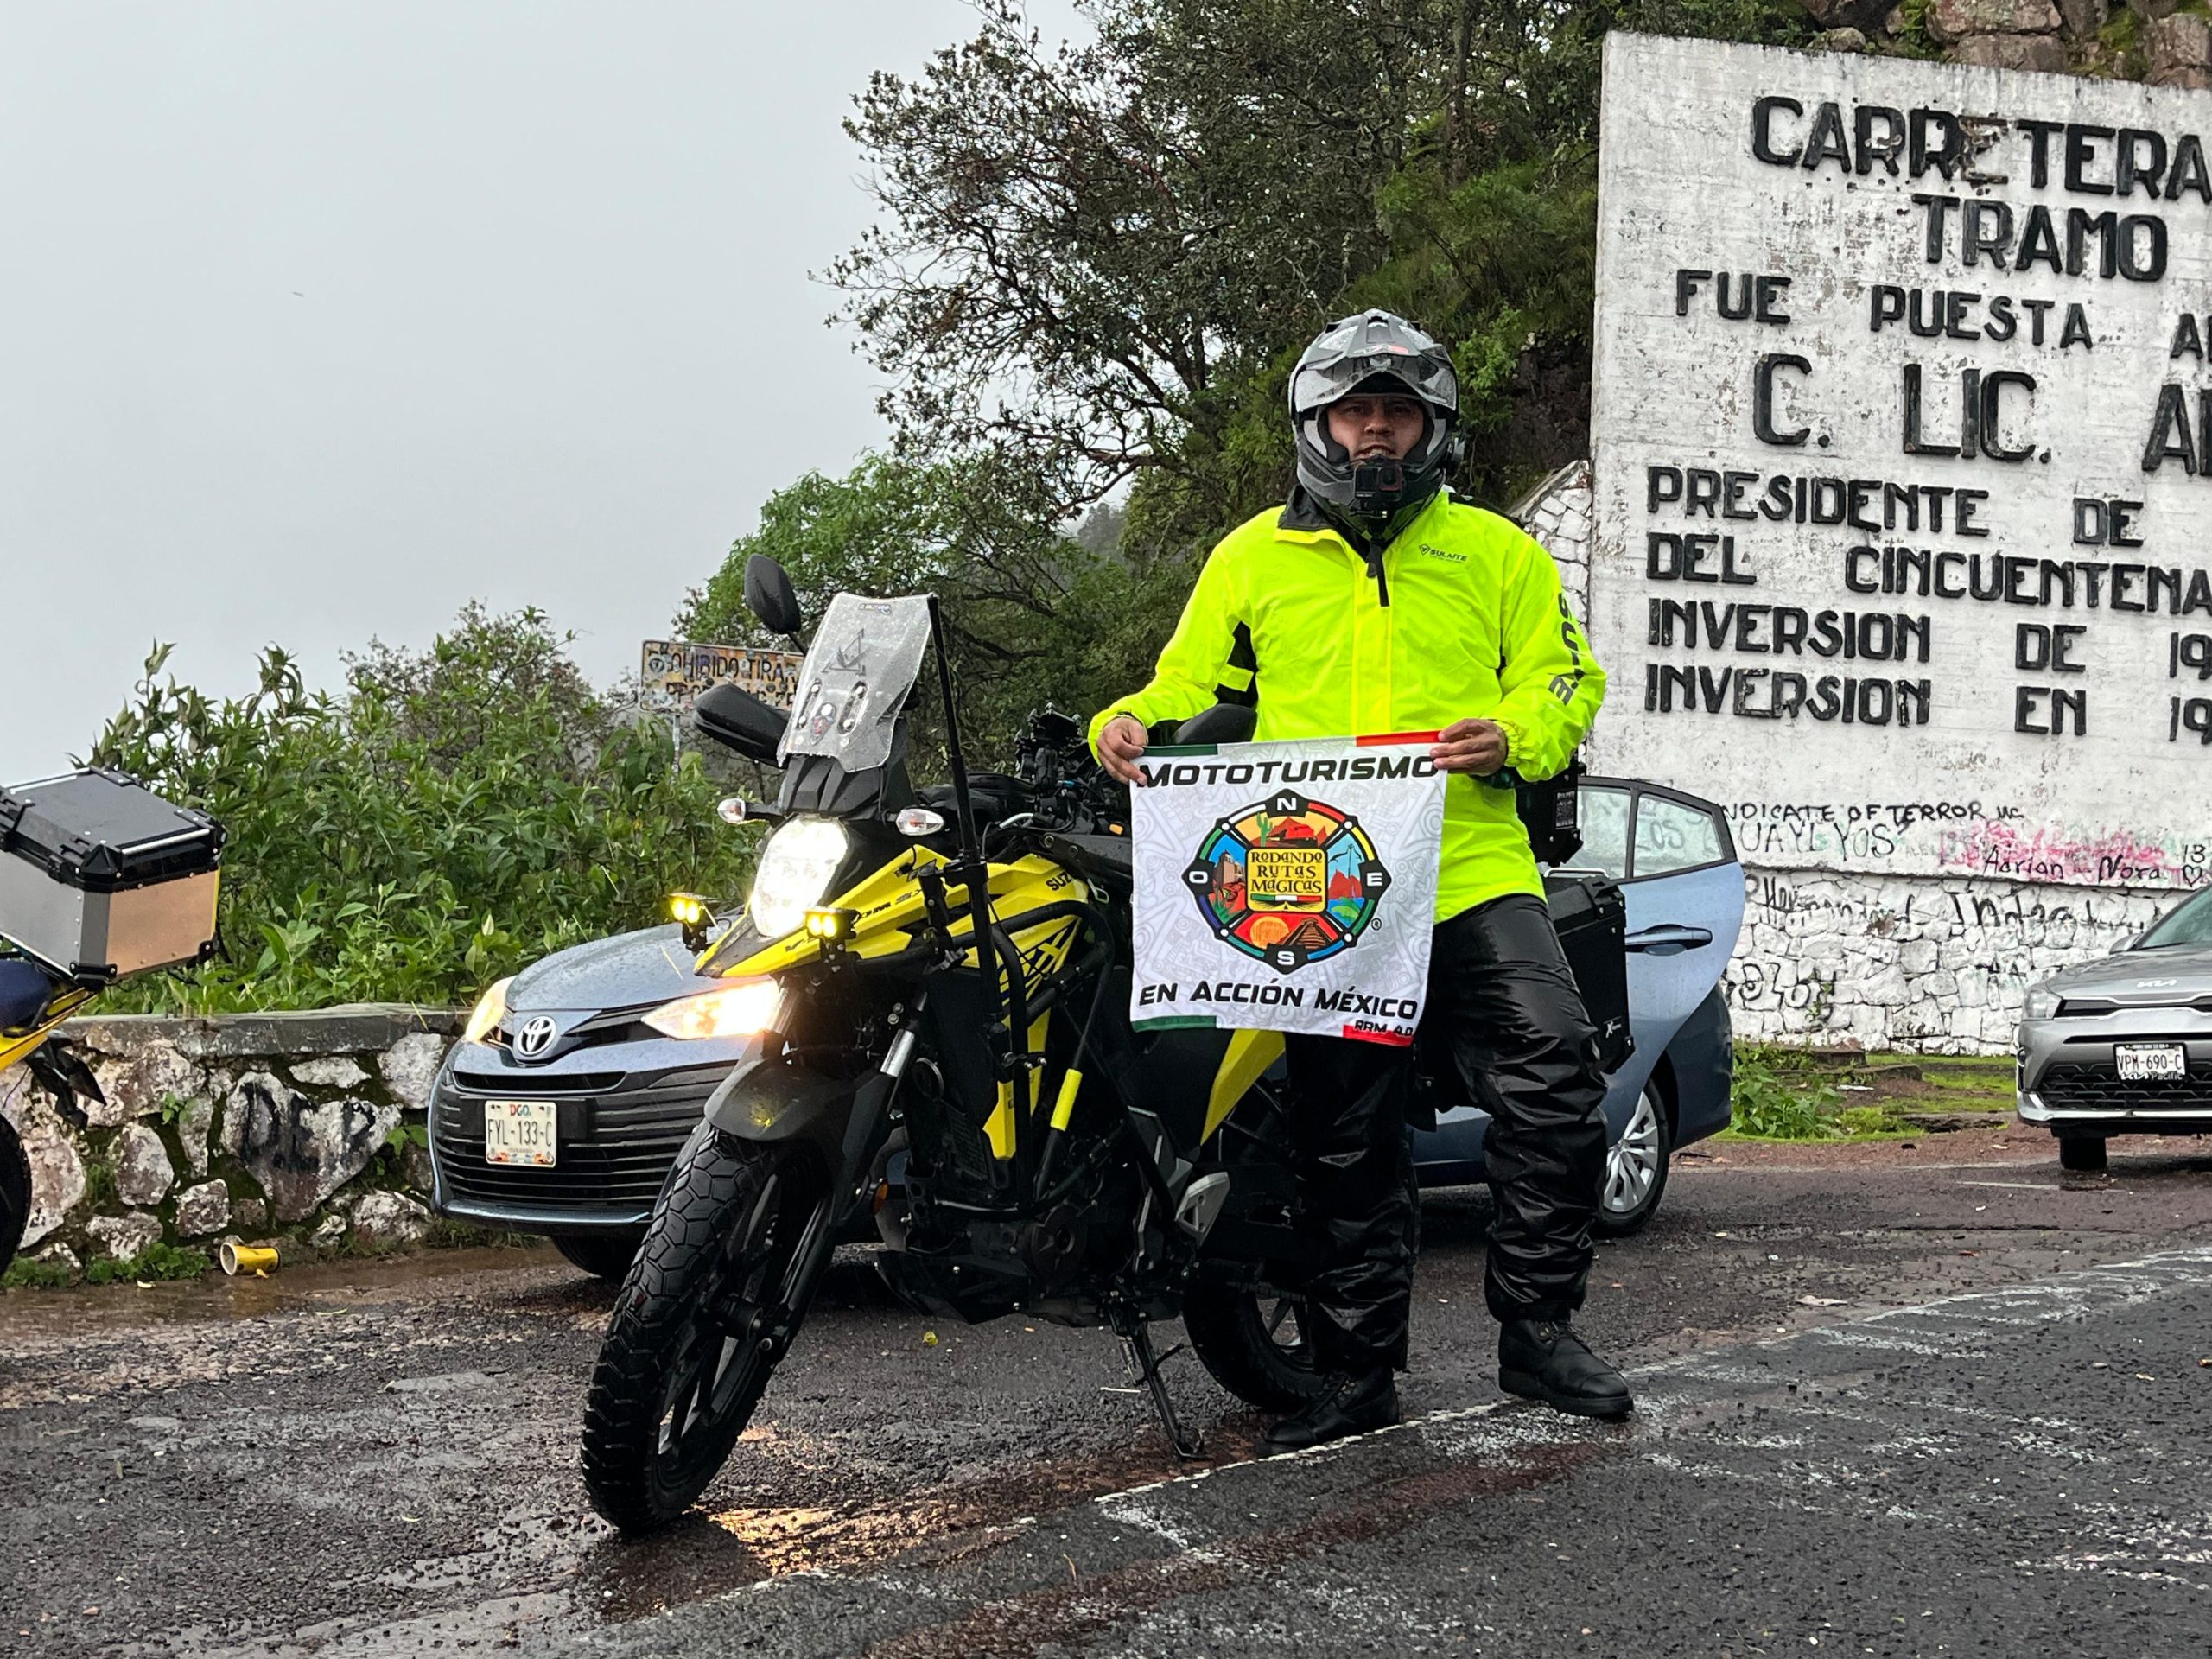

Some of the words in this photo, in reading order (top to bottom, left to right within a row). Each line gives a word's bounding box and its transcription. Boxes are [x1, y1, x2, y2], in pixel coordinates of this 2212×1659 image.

[1912, 194, 2168, 281] TRAMO
[1676, 269, 1791, 324] FUE
[1871, 285, 2092, 349] PUESTA
[1753, 353, 1830, 448] C.
[1904, 364, 2051, 464] LIC.
[1646, 466, 1989, 537] PRESIDENTE
[2074, 497, 2144, 547] DE
[1430, 549, 1468, 562] SULAITE
[1646, 531, 1758, 585] DEL
[1647, 597, 1931, 663] INVERSION
[2016, 622, 2087, 672] DE
[1644, 663, 1931, 727] INVERSION
[2015, 685, 2087, 736] EN
[1136, 755, 1440, 788] MOTOTURISMO
[1276, 798, 1296, 810] N
[1848, 804, 1881, 822] OF
[1886, 800, 1986, 828] TERROR
[1189, 871, 1208, 884] O
[1366, 872, 1383, 886] E
[2099, 855, 2161, 883] Nora
[1277, 951, 1295, 965] S
[1139, 982, 1179, 1007] EN
[1190, 977, 1304, 1007] ACCIÓN
[1314, 986, 1418, 1020] MÉXICO
[1355, 1020, 1388, 1033] RRM
[2117, 1054, 2183, 1071] VPM-690-C
[487, 1119, 553, 1147] FYL-133-C
